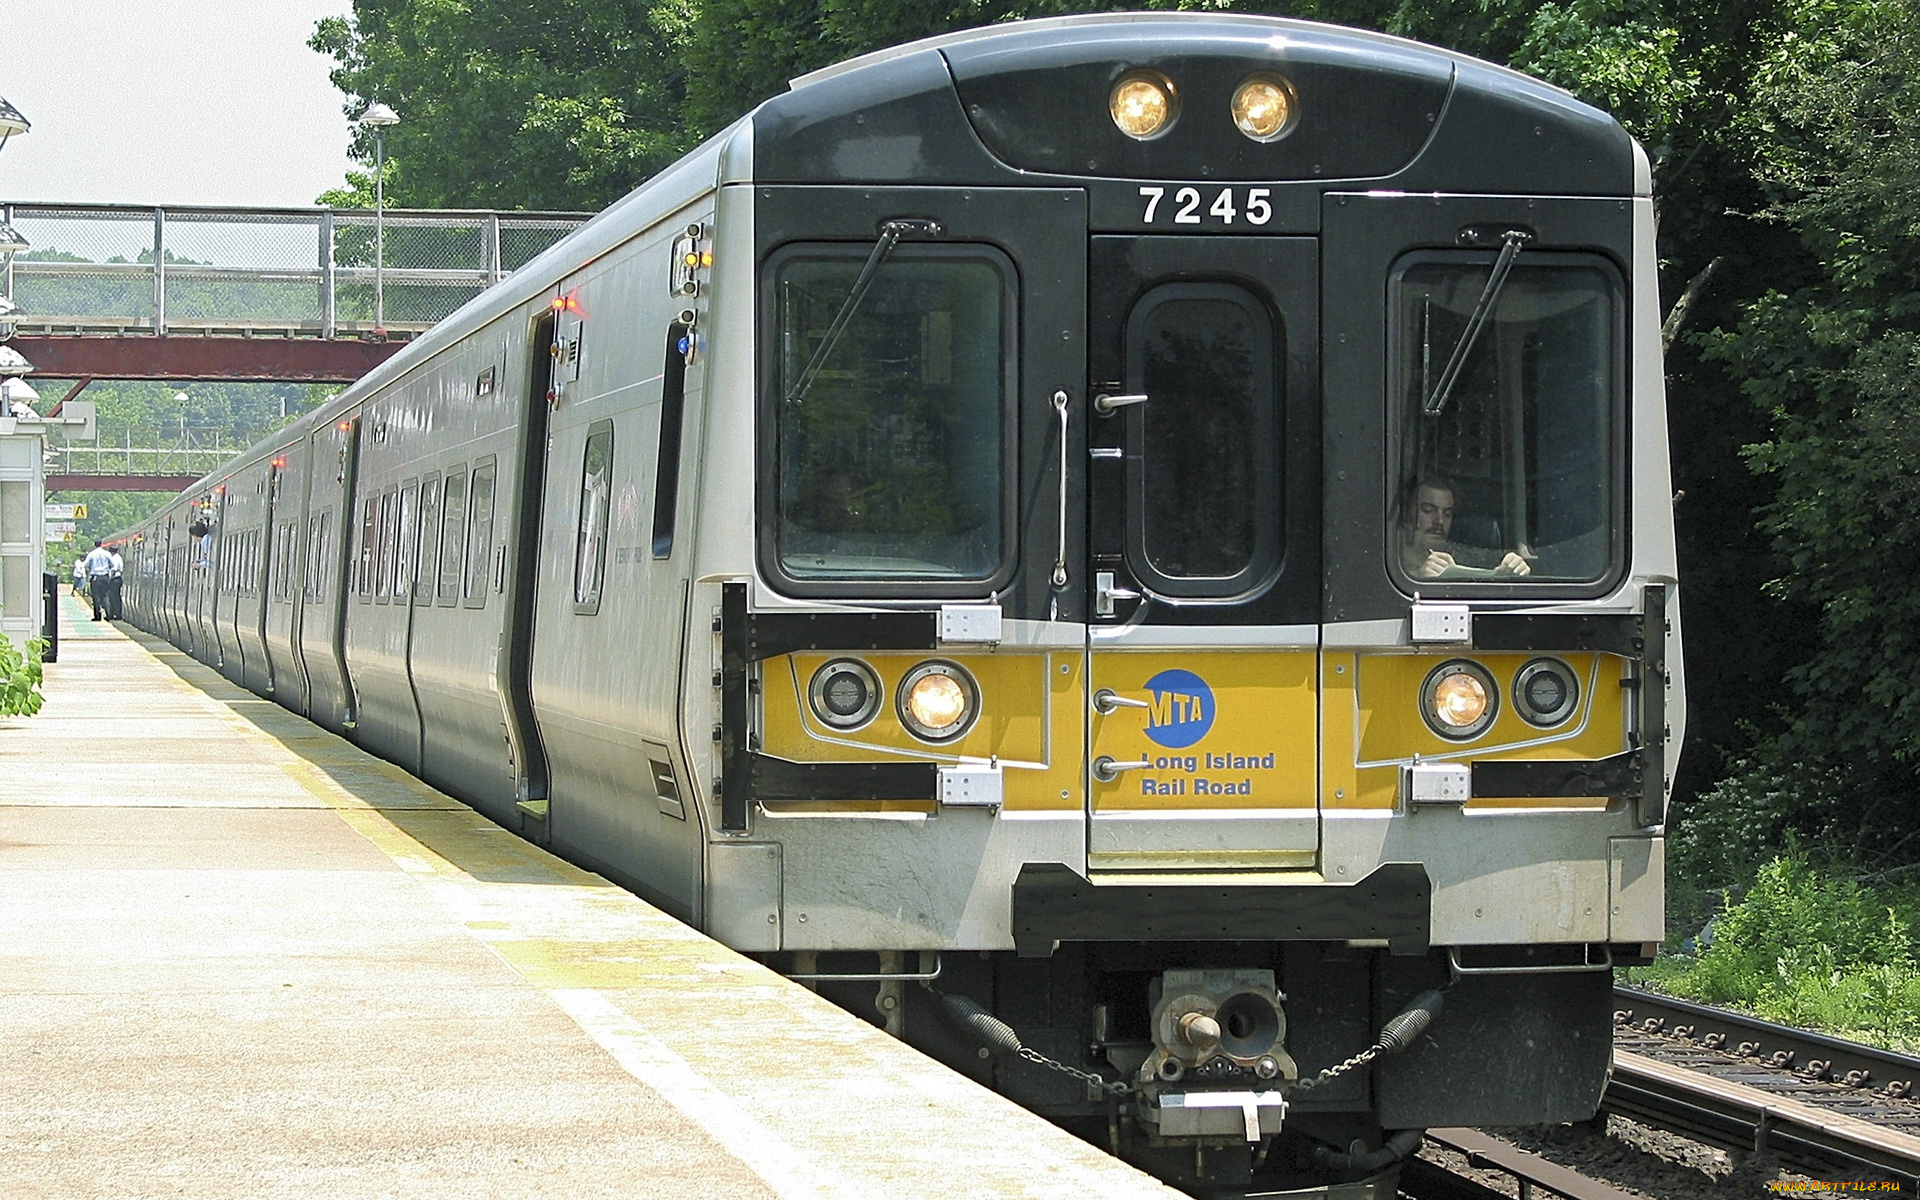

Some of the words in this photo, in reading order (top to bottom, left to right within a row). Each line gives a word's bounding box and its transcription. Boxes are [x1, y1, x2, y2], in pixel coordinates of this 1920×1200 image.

[1139, 186, 1272, 225] 7245
[1142, 689, 1203, 728] MTA
[1141, 752, 1197, 773] Long
[1206, 752, 1275, 769] Island
[1141, 778, 1186, 795] Rail
[1194, 778, 1252, 795] Road
